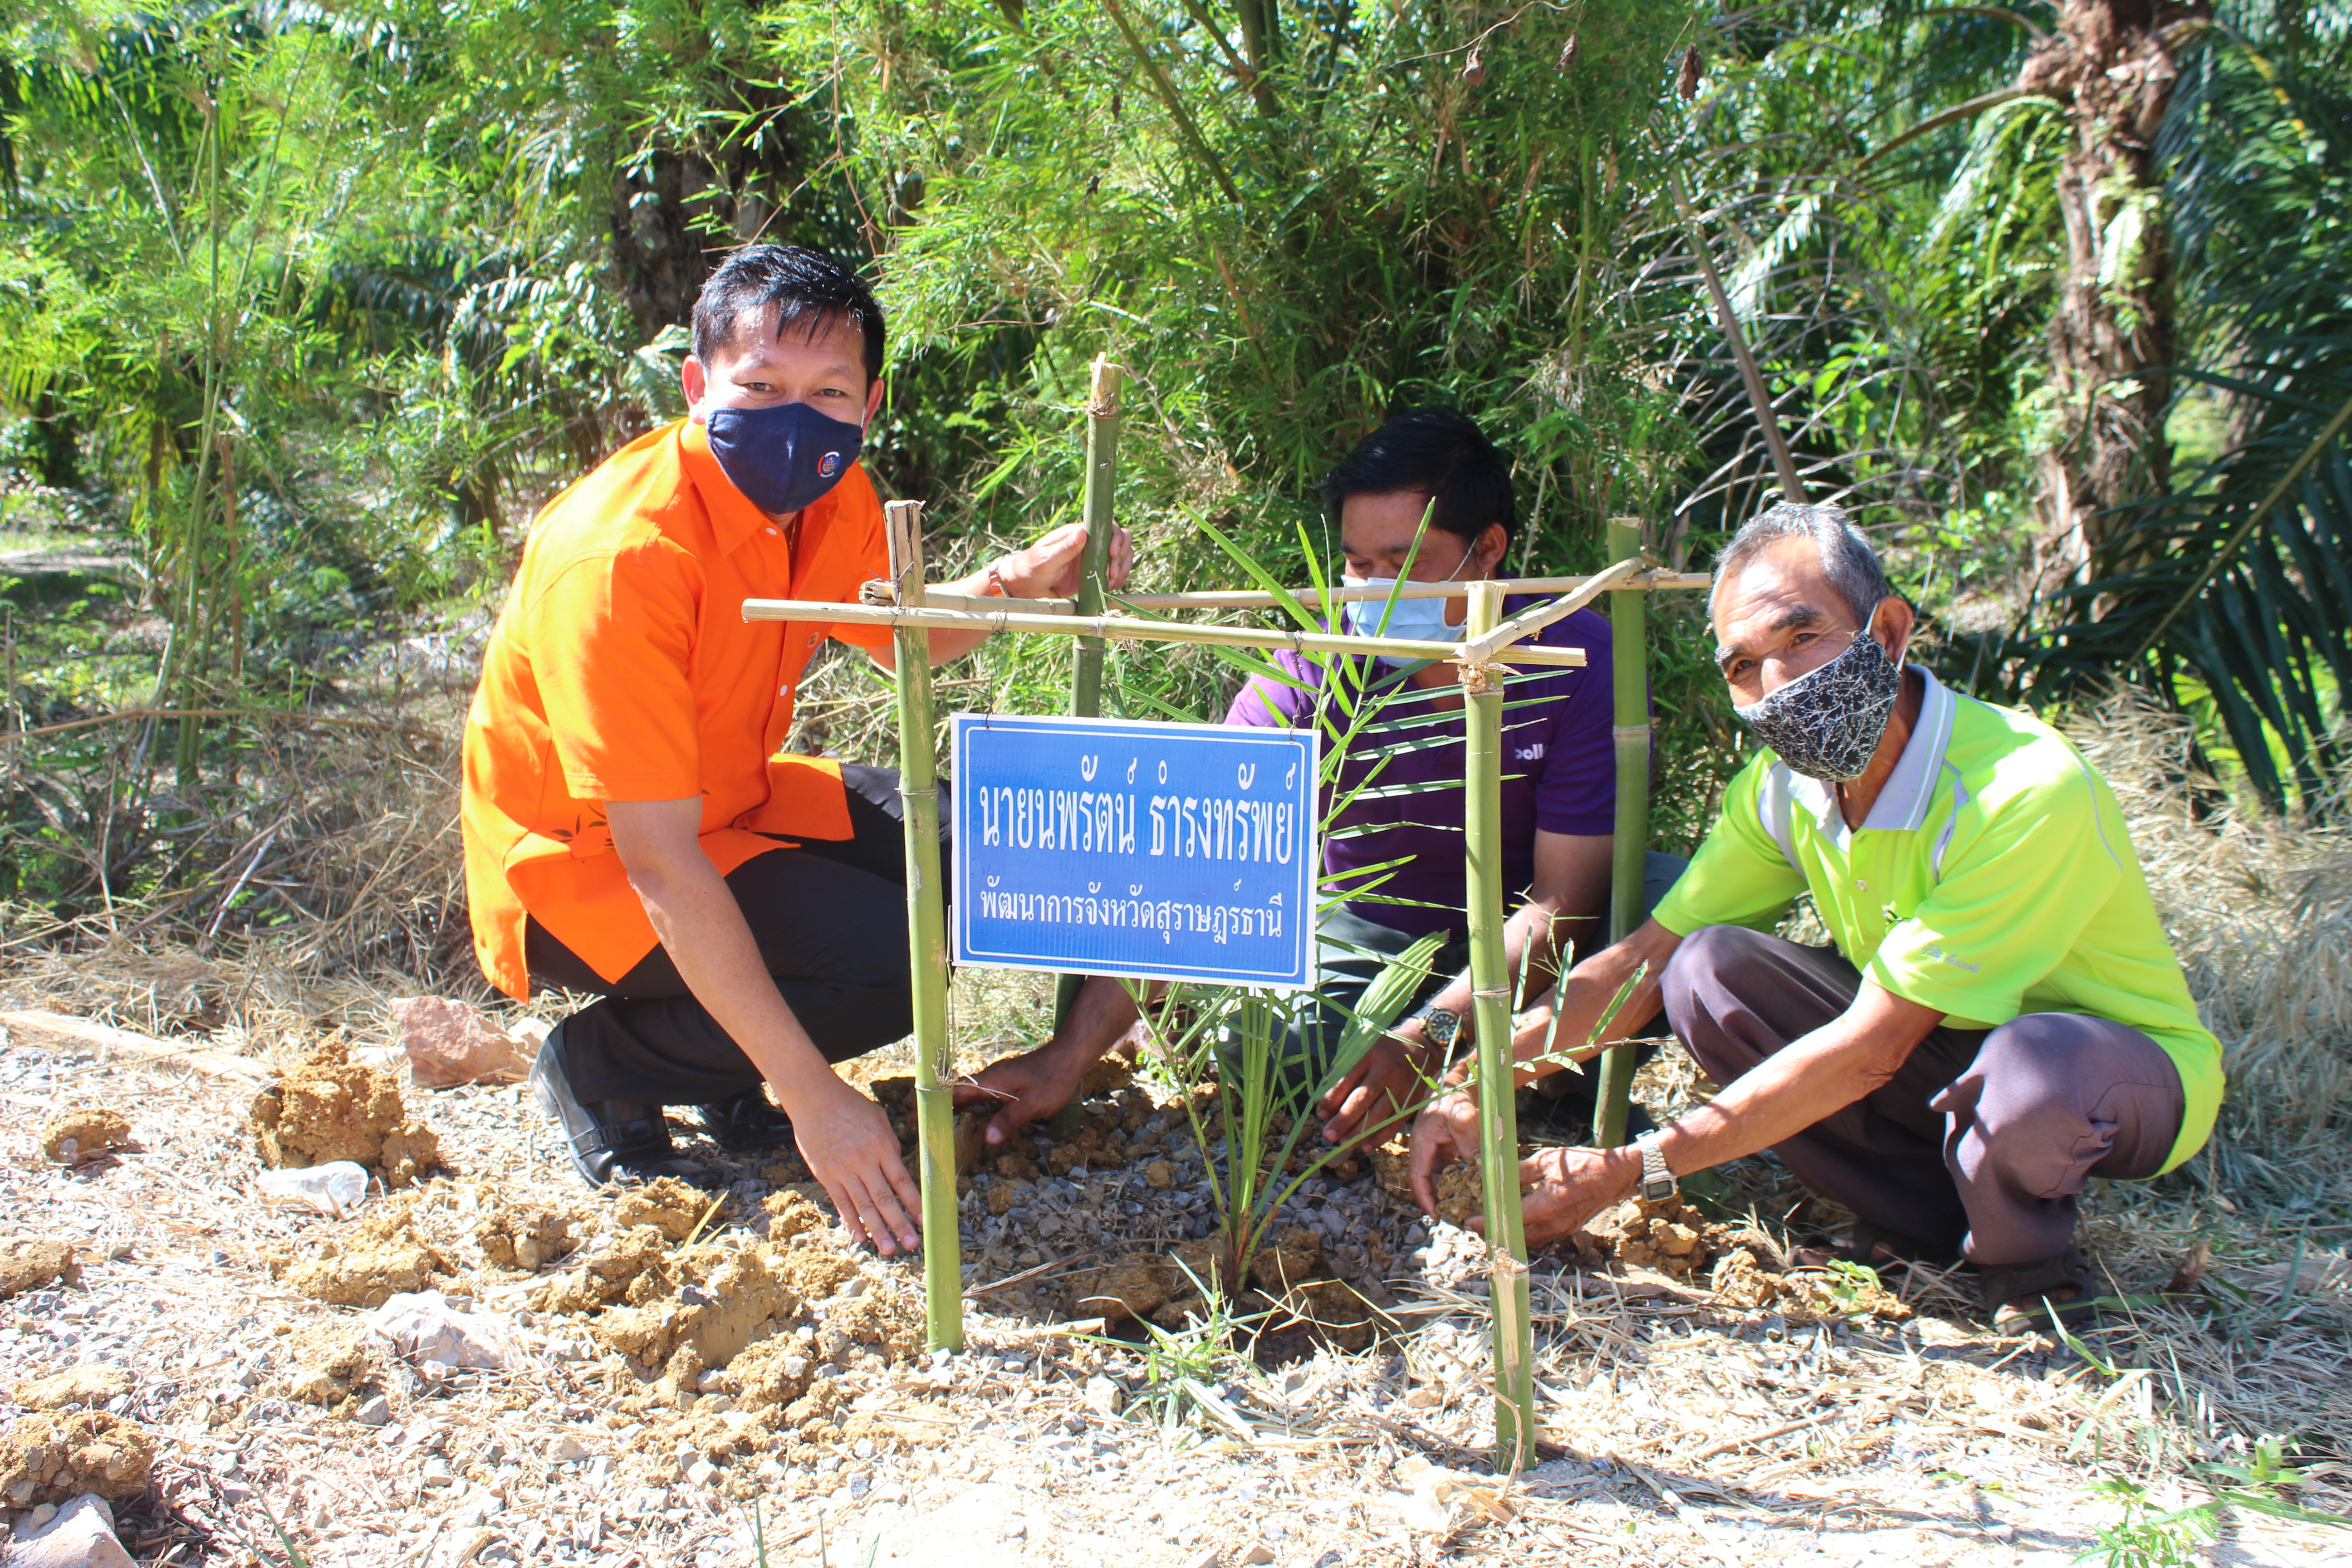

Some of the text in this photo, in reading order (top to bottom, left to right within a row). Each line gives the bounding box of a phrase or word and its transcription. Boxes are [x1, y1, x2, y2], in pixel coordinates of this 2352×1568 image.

[980, 755, 1296, 864] นายนพรัตน์ ธำรงทรัพย์
[980, 875, 1282, 944] พัฒนาการจังหวัดสุราษฎร์ธานี
